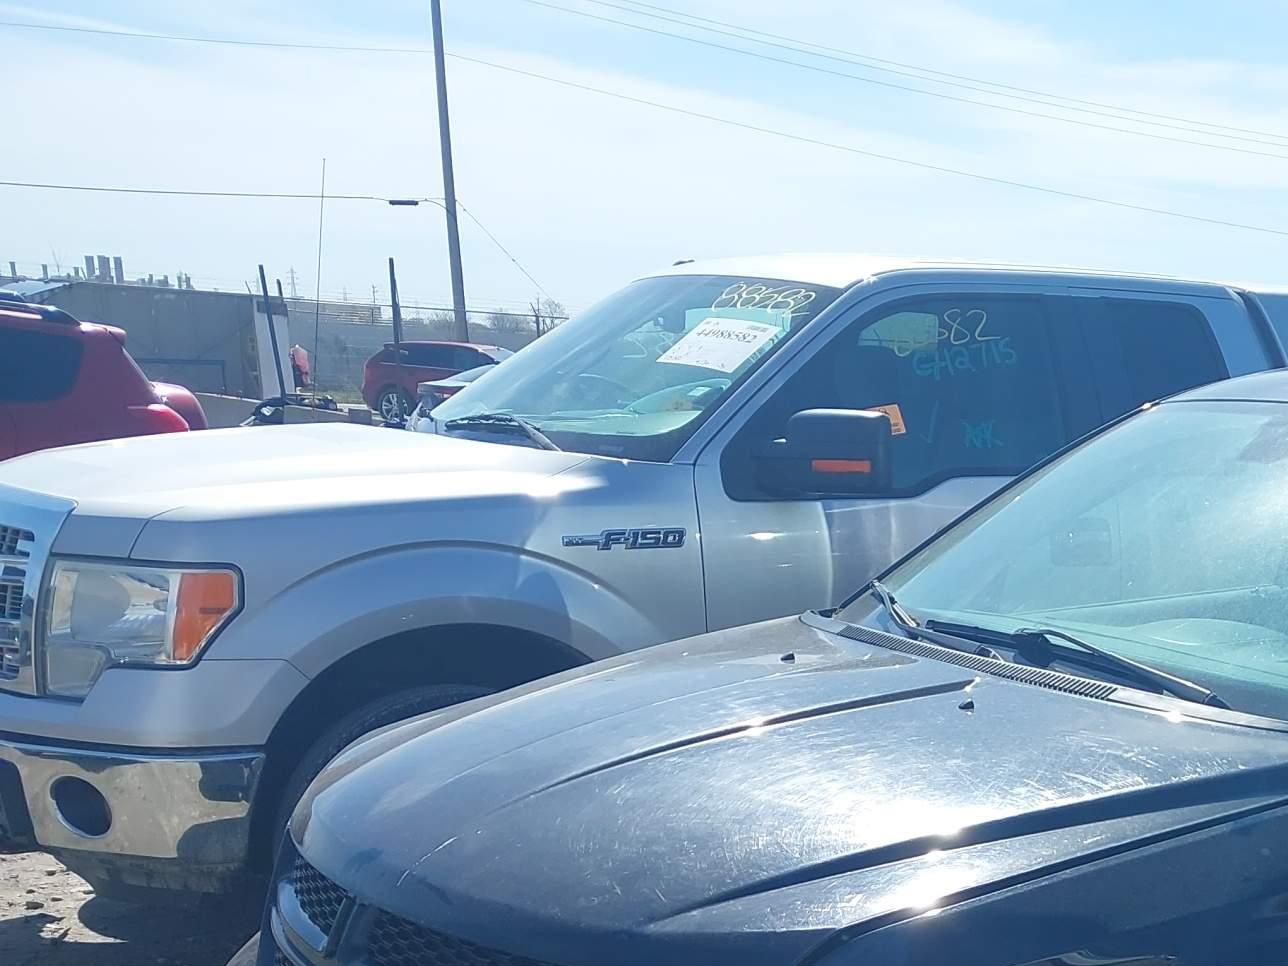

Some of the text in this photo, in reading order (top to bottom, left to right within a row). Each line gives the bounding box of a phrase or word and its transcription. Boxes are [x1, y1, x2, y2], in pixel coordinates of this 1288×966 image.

[712, 281, 817, 317] 88582
[695, 326, 759, 344] 44988582
[597, 528, 687, 551] F-150
